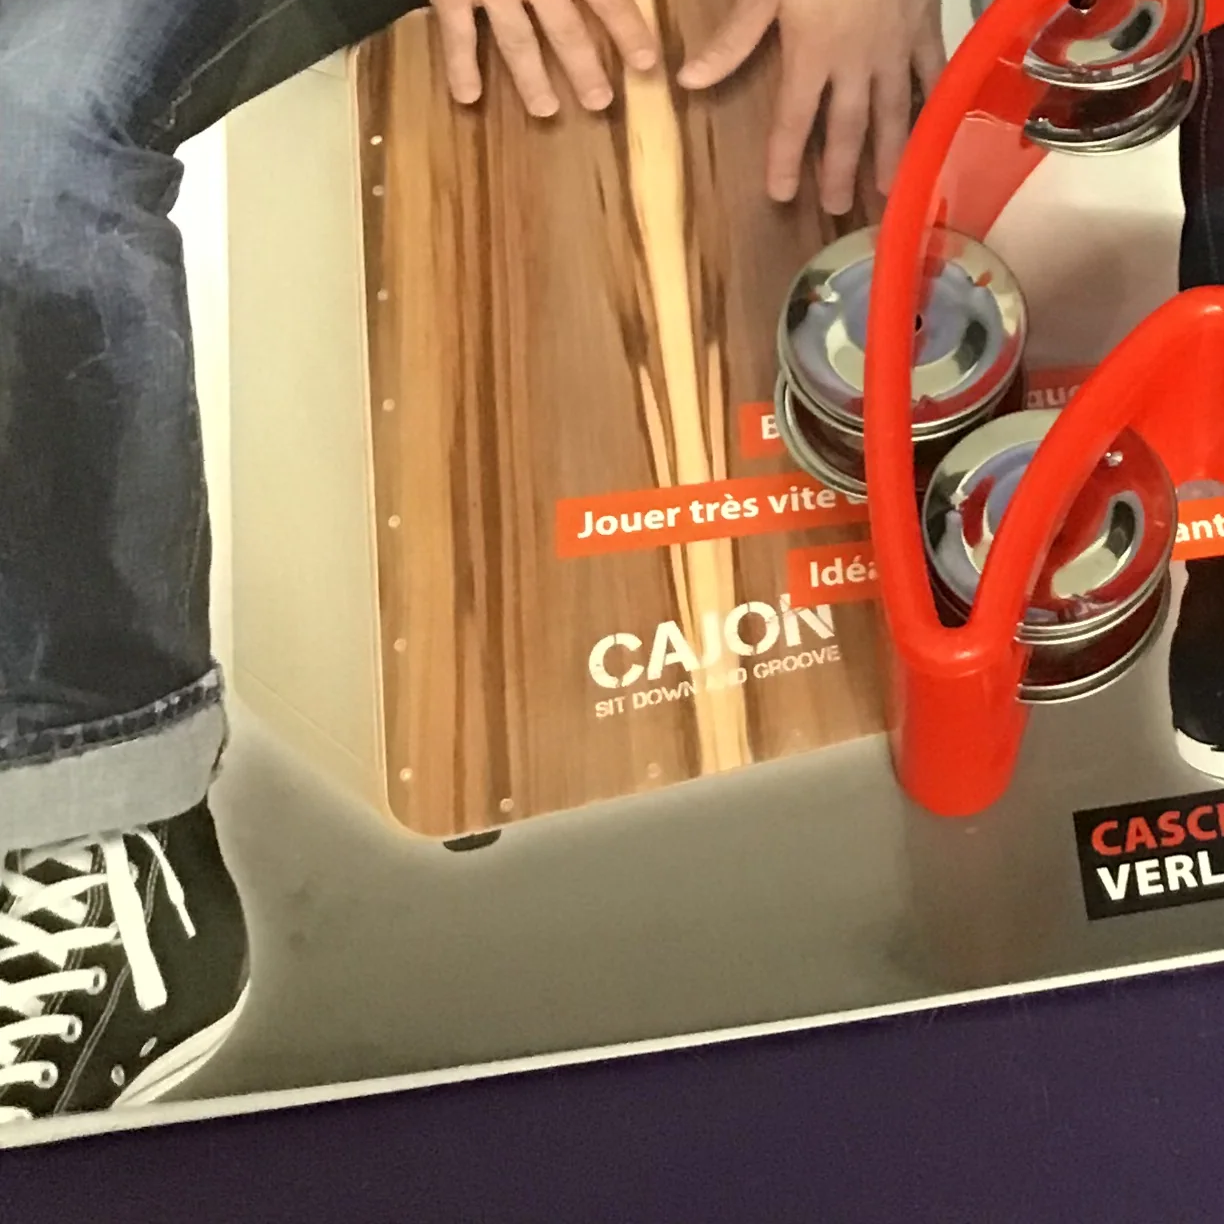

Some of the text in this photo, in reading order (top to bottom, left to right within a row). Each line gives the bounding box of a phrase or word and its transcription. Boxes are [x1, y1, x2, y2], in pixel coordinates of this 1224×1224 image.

[577, 504, 681, 539] Jouer
[689, 493, 760, 524] très
[767, 484, 837, 514] vite
[588, 592, 836, 689] CAJON
[594, 695, 627, 718] SIT
[753, 644, 841, 680] GROOVE
